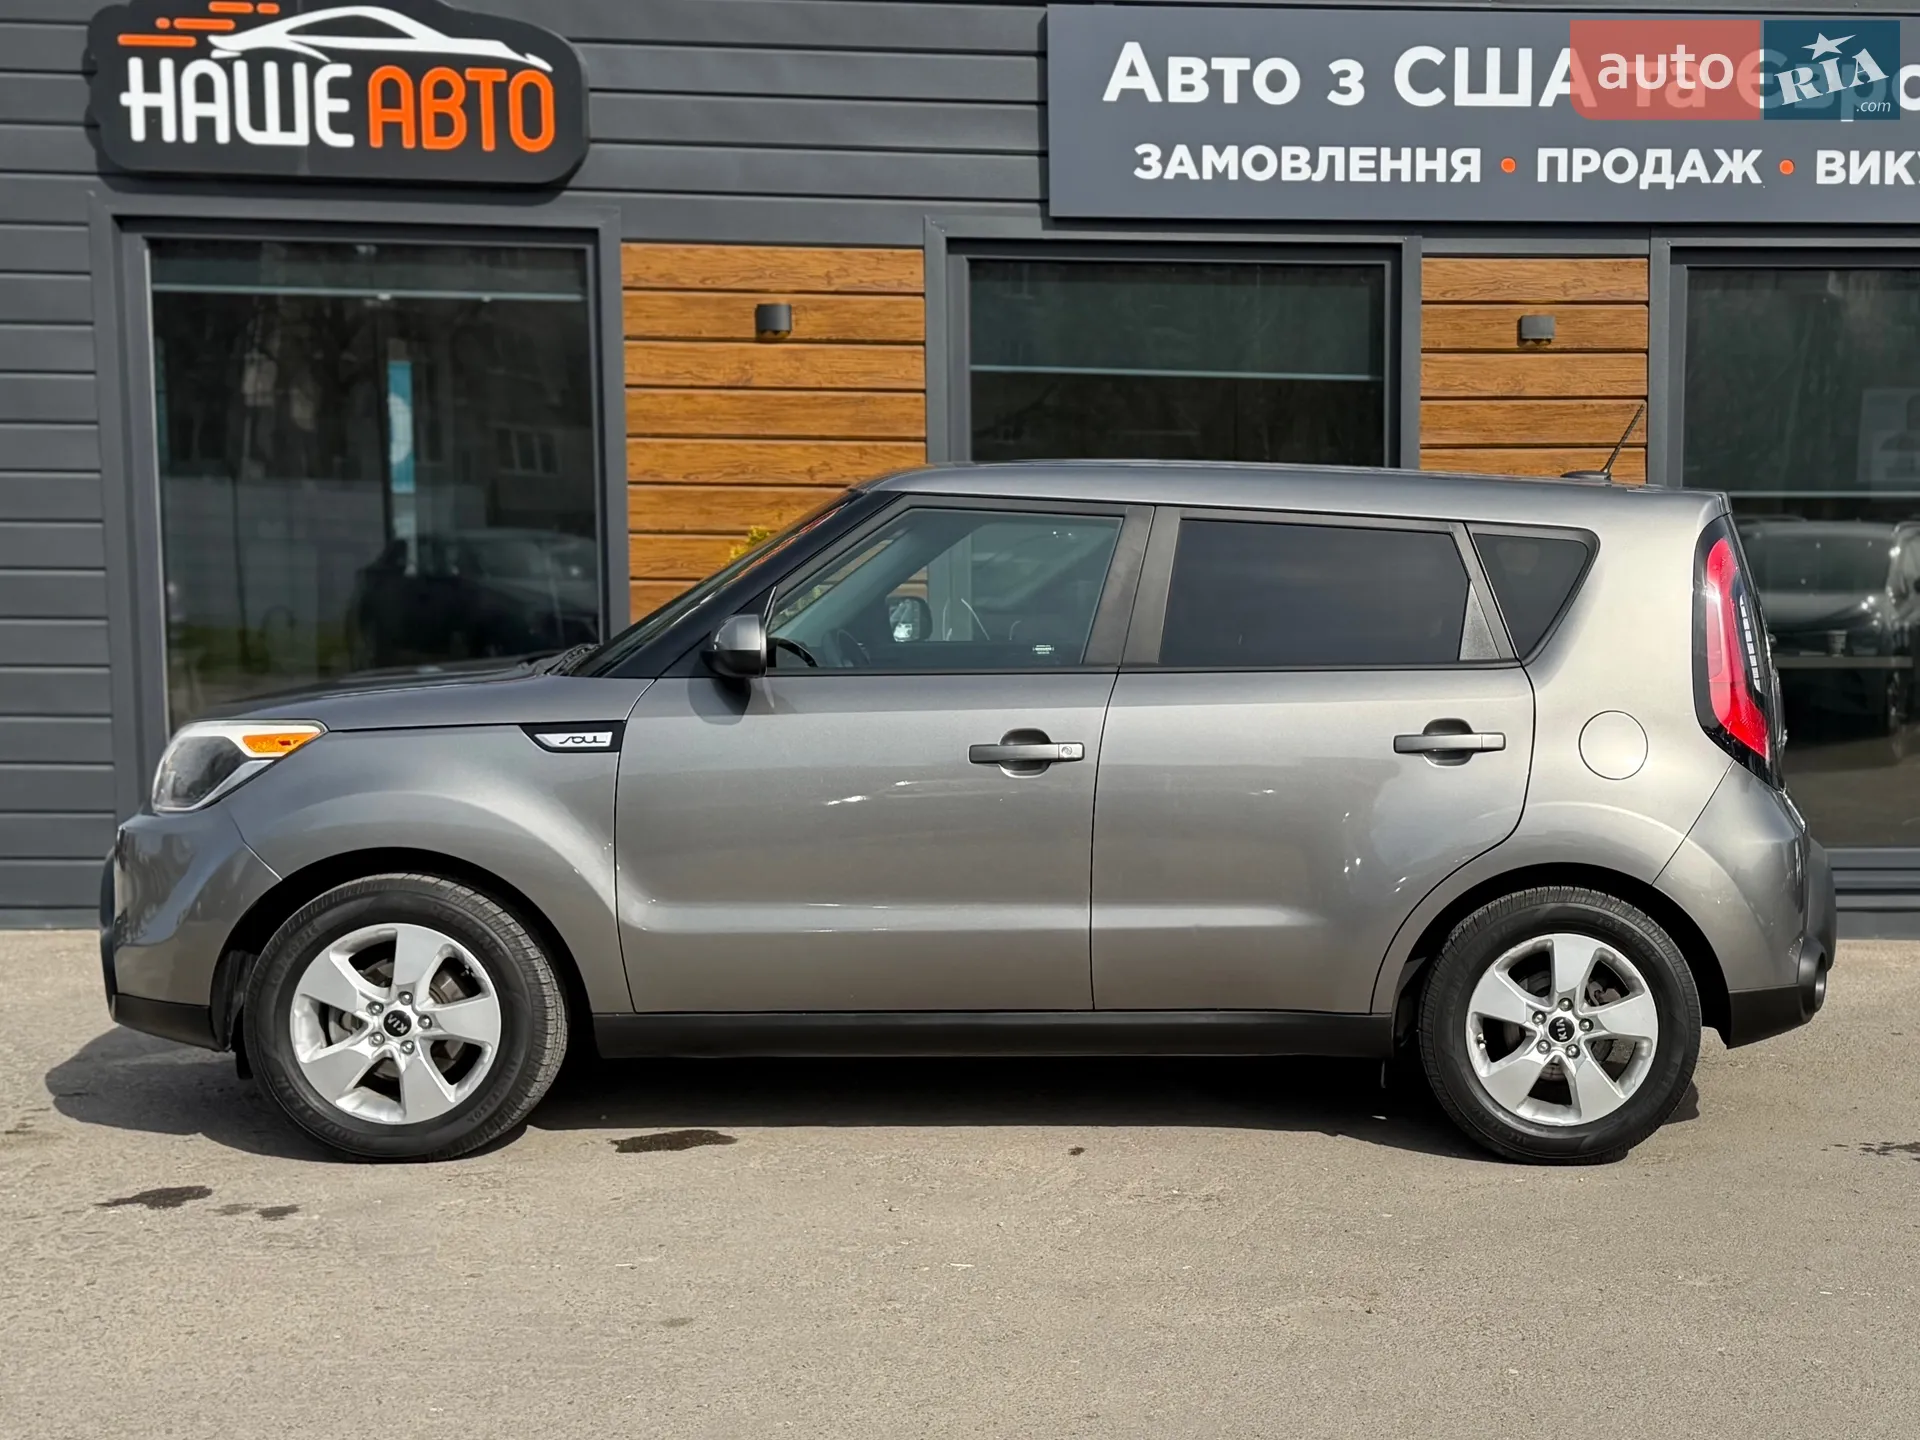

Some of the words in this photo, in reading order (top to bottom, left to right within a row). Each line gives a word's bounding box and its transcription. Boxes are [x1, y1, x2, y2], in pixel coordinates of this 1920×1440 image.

[1327, 58, 1365, 106] з
[1393, 45, 1598, 107] США
[120, 57, 355, 148] НАШЕ
[367, 65, 556, 153] АВТО
[1133, 143, 1481, 183] ЗАМОВЛЕННЯ
[1537, 147, 1763, 190] ПРОДАЖ
[1816, 149, 1920, 186] ВИК
[387, 1013, 408, 1034] KIA
[1556, 1018, 1568, 1040] KIA
